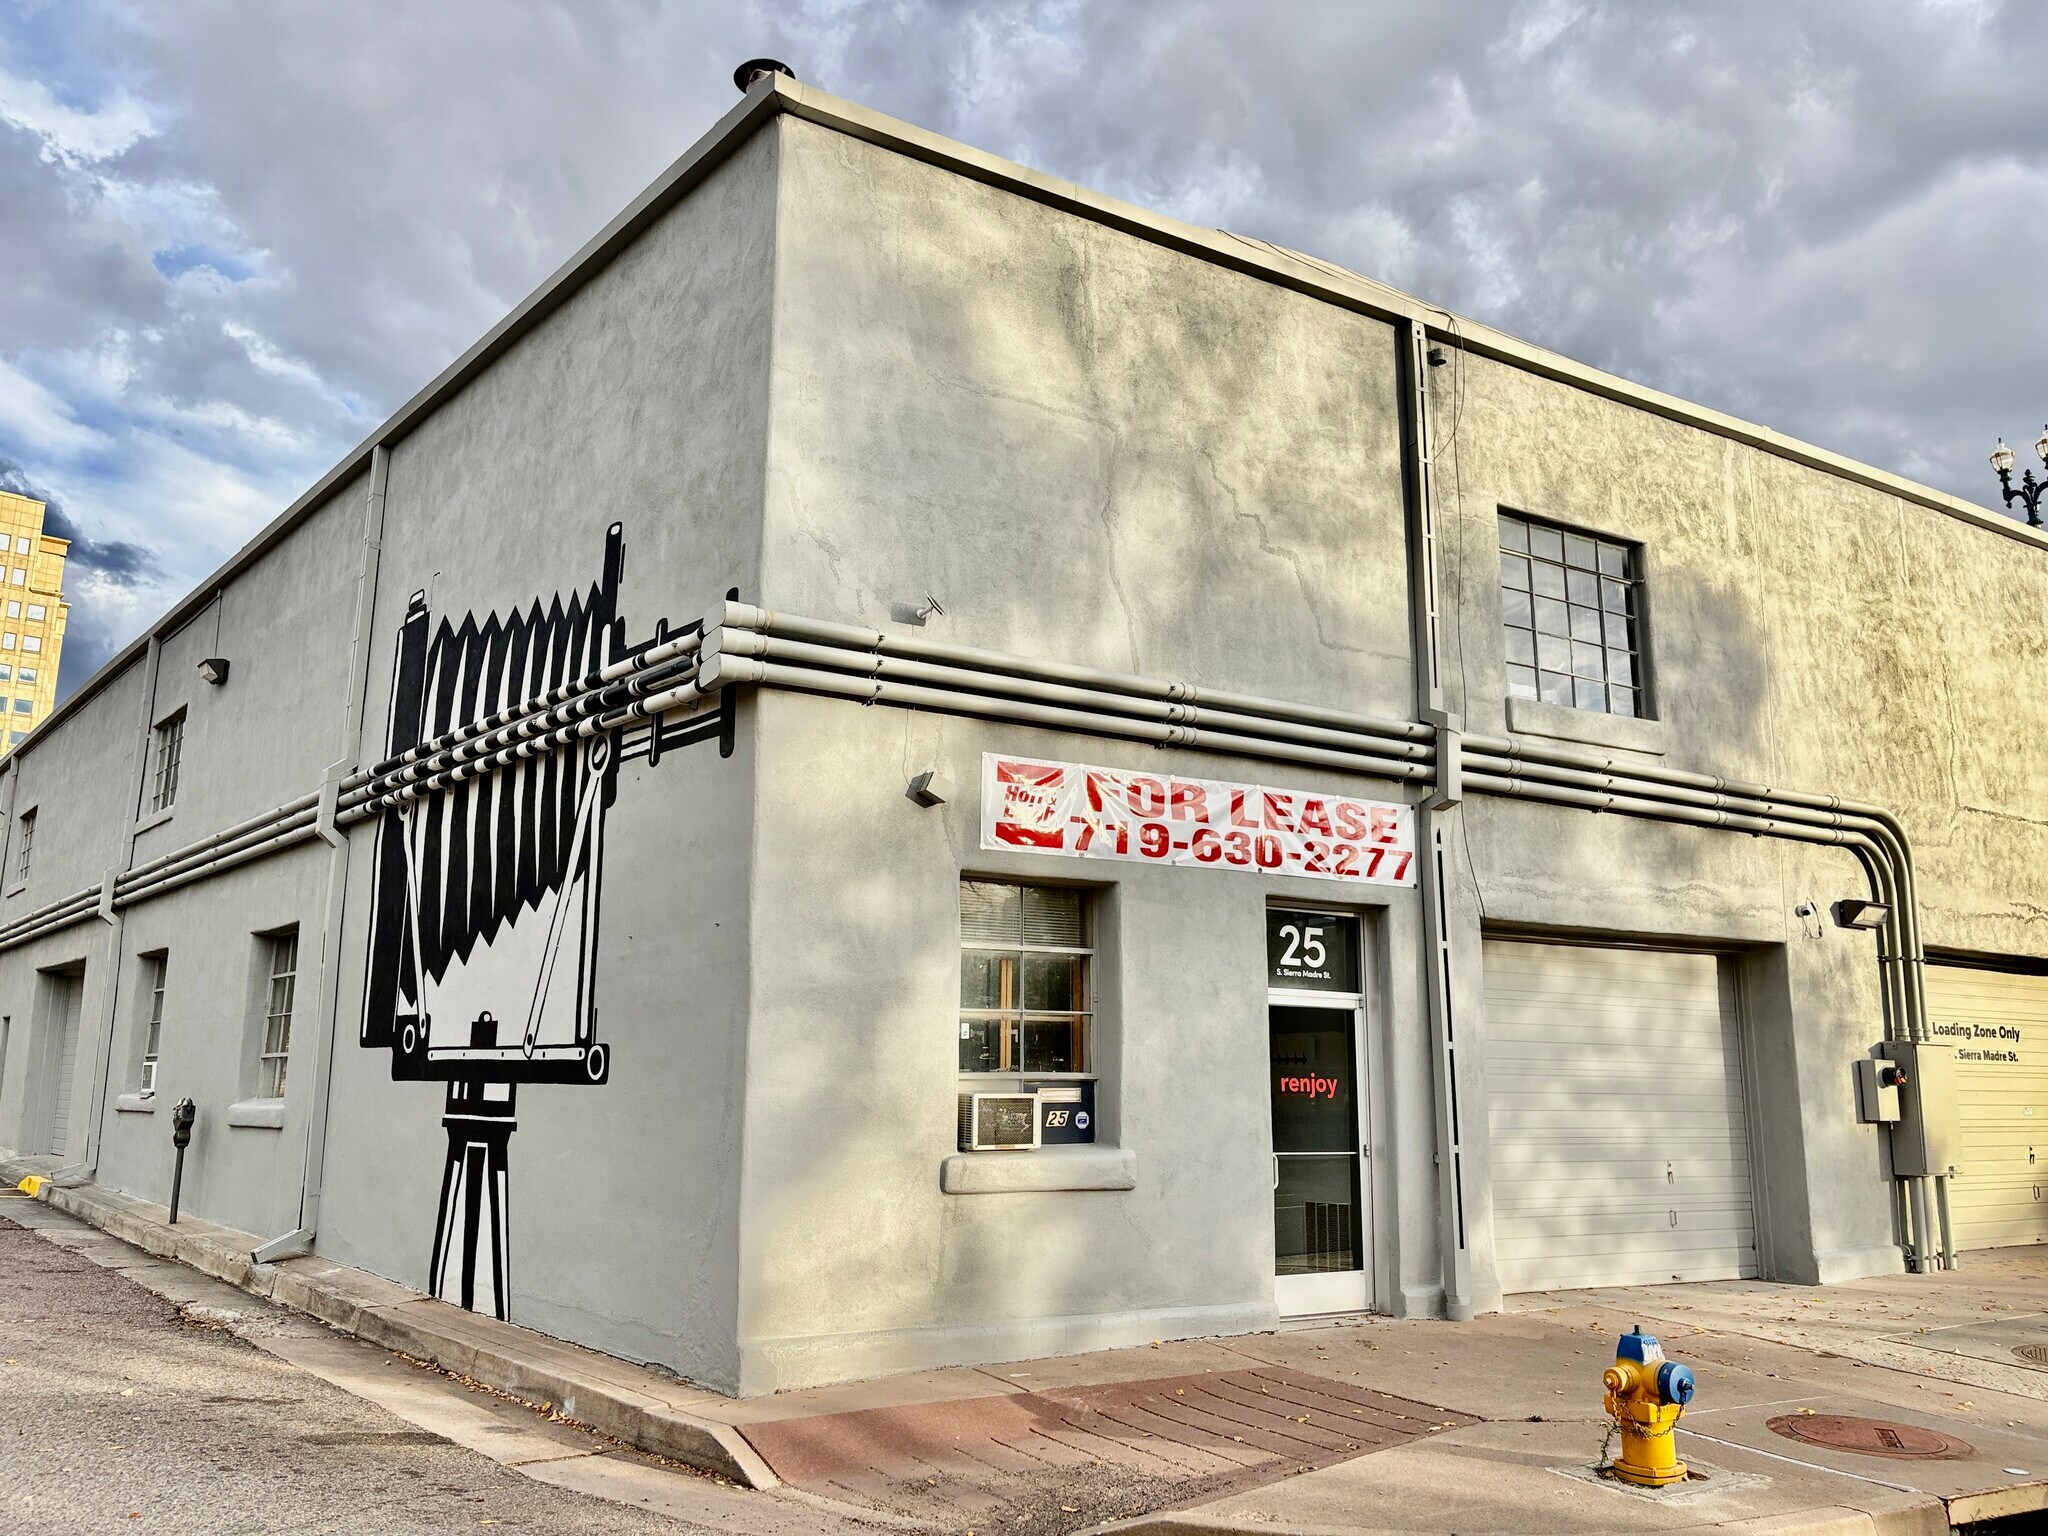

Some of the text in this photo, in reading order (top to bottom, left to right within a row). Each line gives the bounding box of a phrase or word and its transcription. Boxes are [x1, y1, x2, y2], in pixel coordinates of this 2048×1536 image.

[1086, 771, 1398, 845] FOR LEASE
[1070, 815, 1413, 881] 719-630-2277
[1279, 924, 1326, 968] 25
[1276, 967, 1331, 979] S. Sierra Madre St.
[1932, 1021, 2020, 1043] Loading Zone Only
[1958, 1048, 1982, 1061] Sierra
[1983, 1050, 2007, 1062] Madre
[2008, 1051, 2019, 1062] St.
[1280, 1072, 1338, 1099] renjoy
[1048, 1112, 1067, 1125] 25
